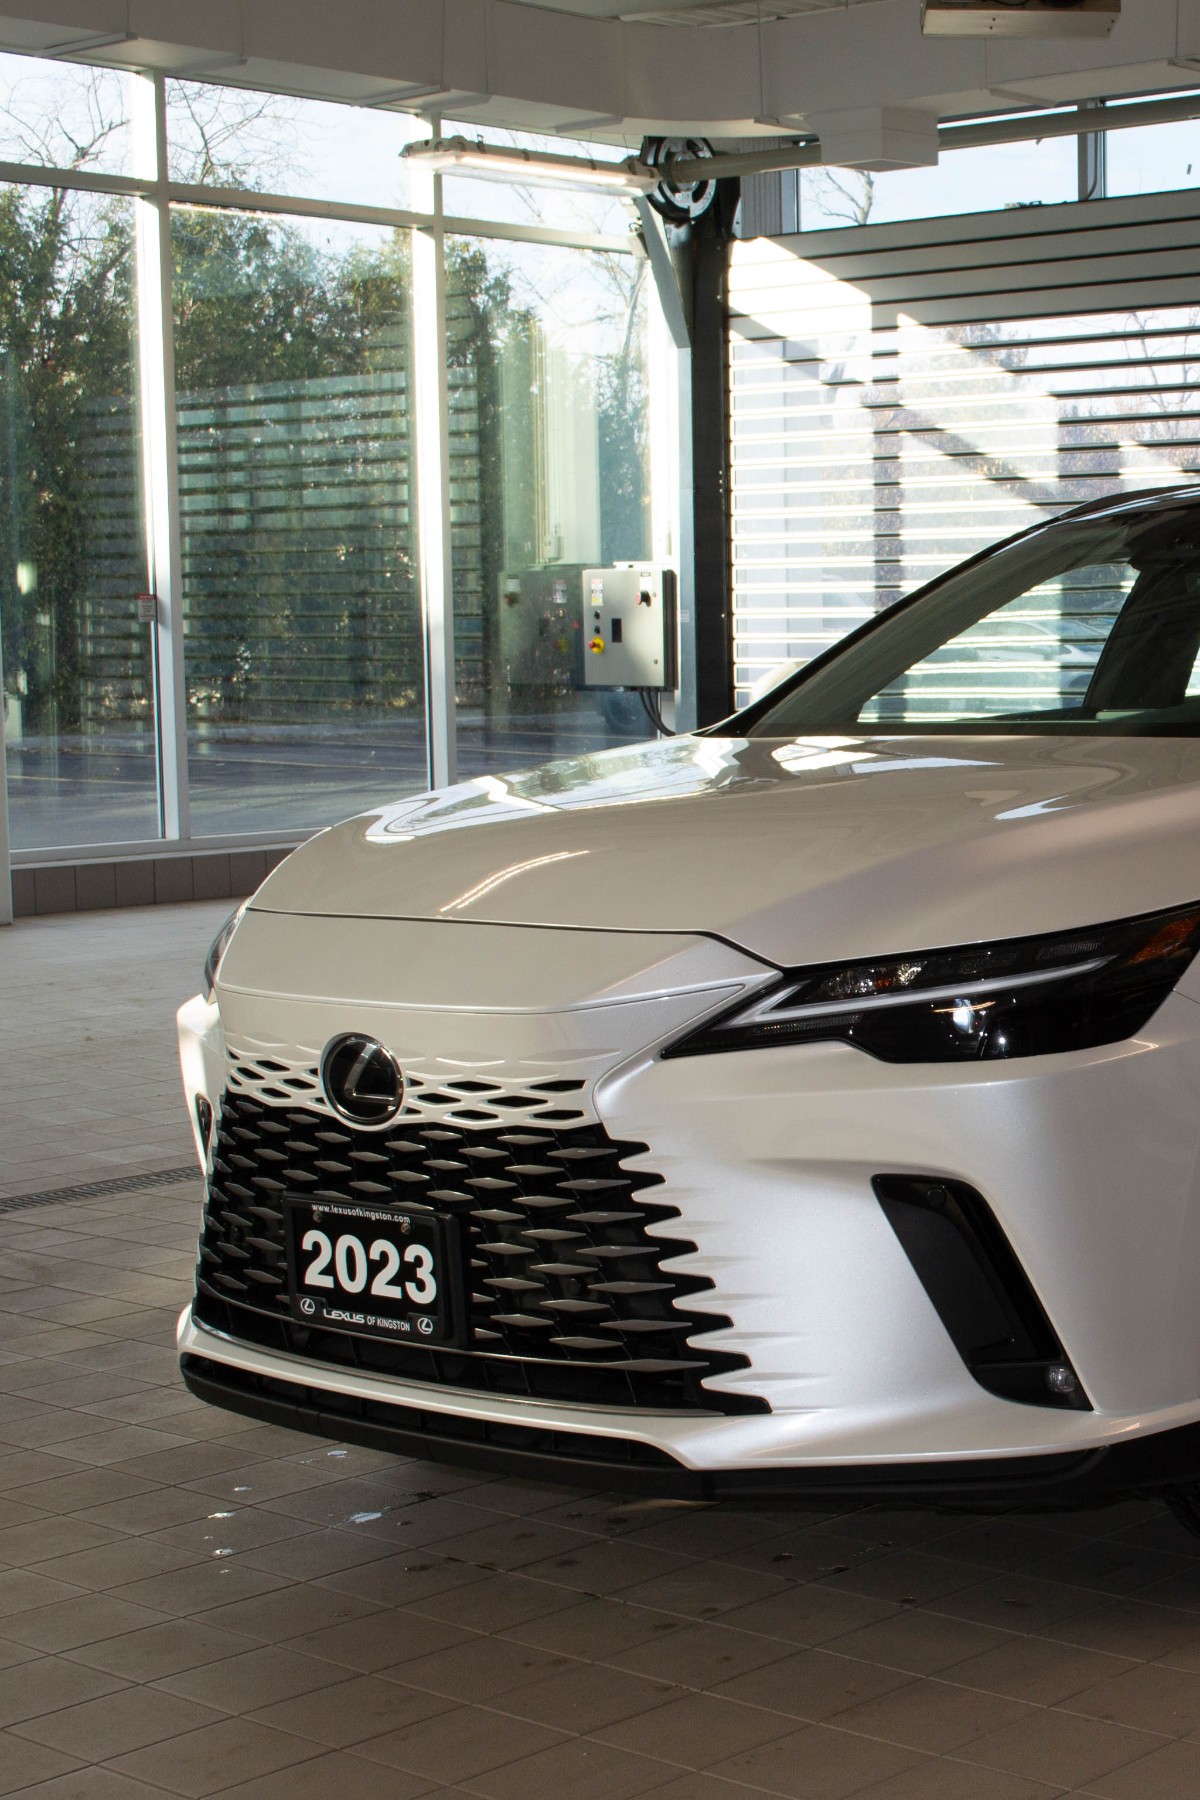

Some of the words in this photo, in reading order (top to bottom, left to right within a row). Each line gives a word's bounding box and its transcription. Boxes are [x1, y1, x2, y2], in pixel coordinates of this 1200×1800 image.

[311, 1203, 411, 1224] www.lexusofkingston.com
[302, 1229, 437, 1305] 2023
[323, 1308, 366, 1324] LEXUS
[366, 1316, 376, 1326] OF
[376, 1318, 411, 1332] KINGSTON
